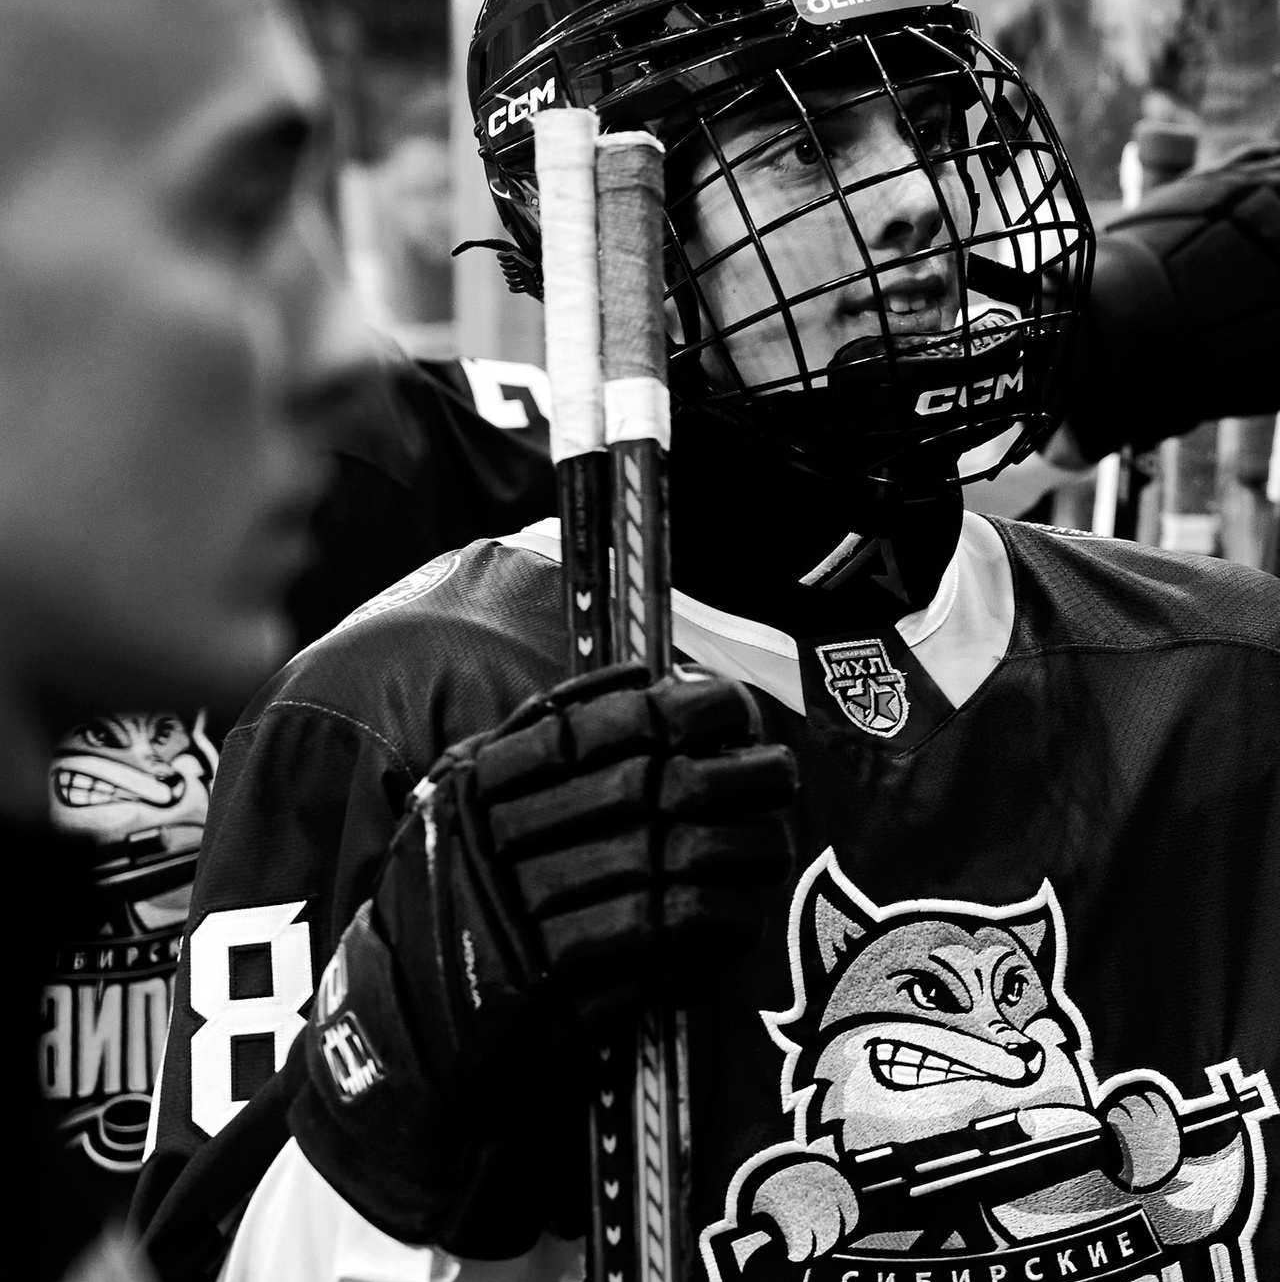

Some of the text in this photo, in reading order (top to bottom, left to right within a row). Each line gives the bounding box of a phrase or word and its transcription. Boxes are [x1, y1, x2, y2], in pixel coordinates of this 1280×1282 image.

[488, 76, 556, 138] CCM
[915, 365, 1024, 416] CCM
[831, 657, 887, 679] МХЛ
[180, 899, 314, 1142] 8
